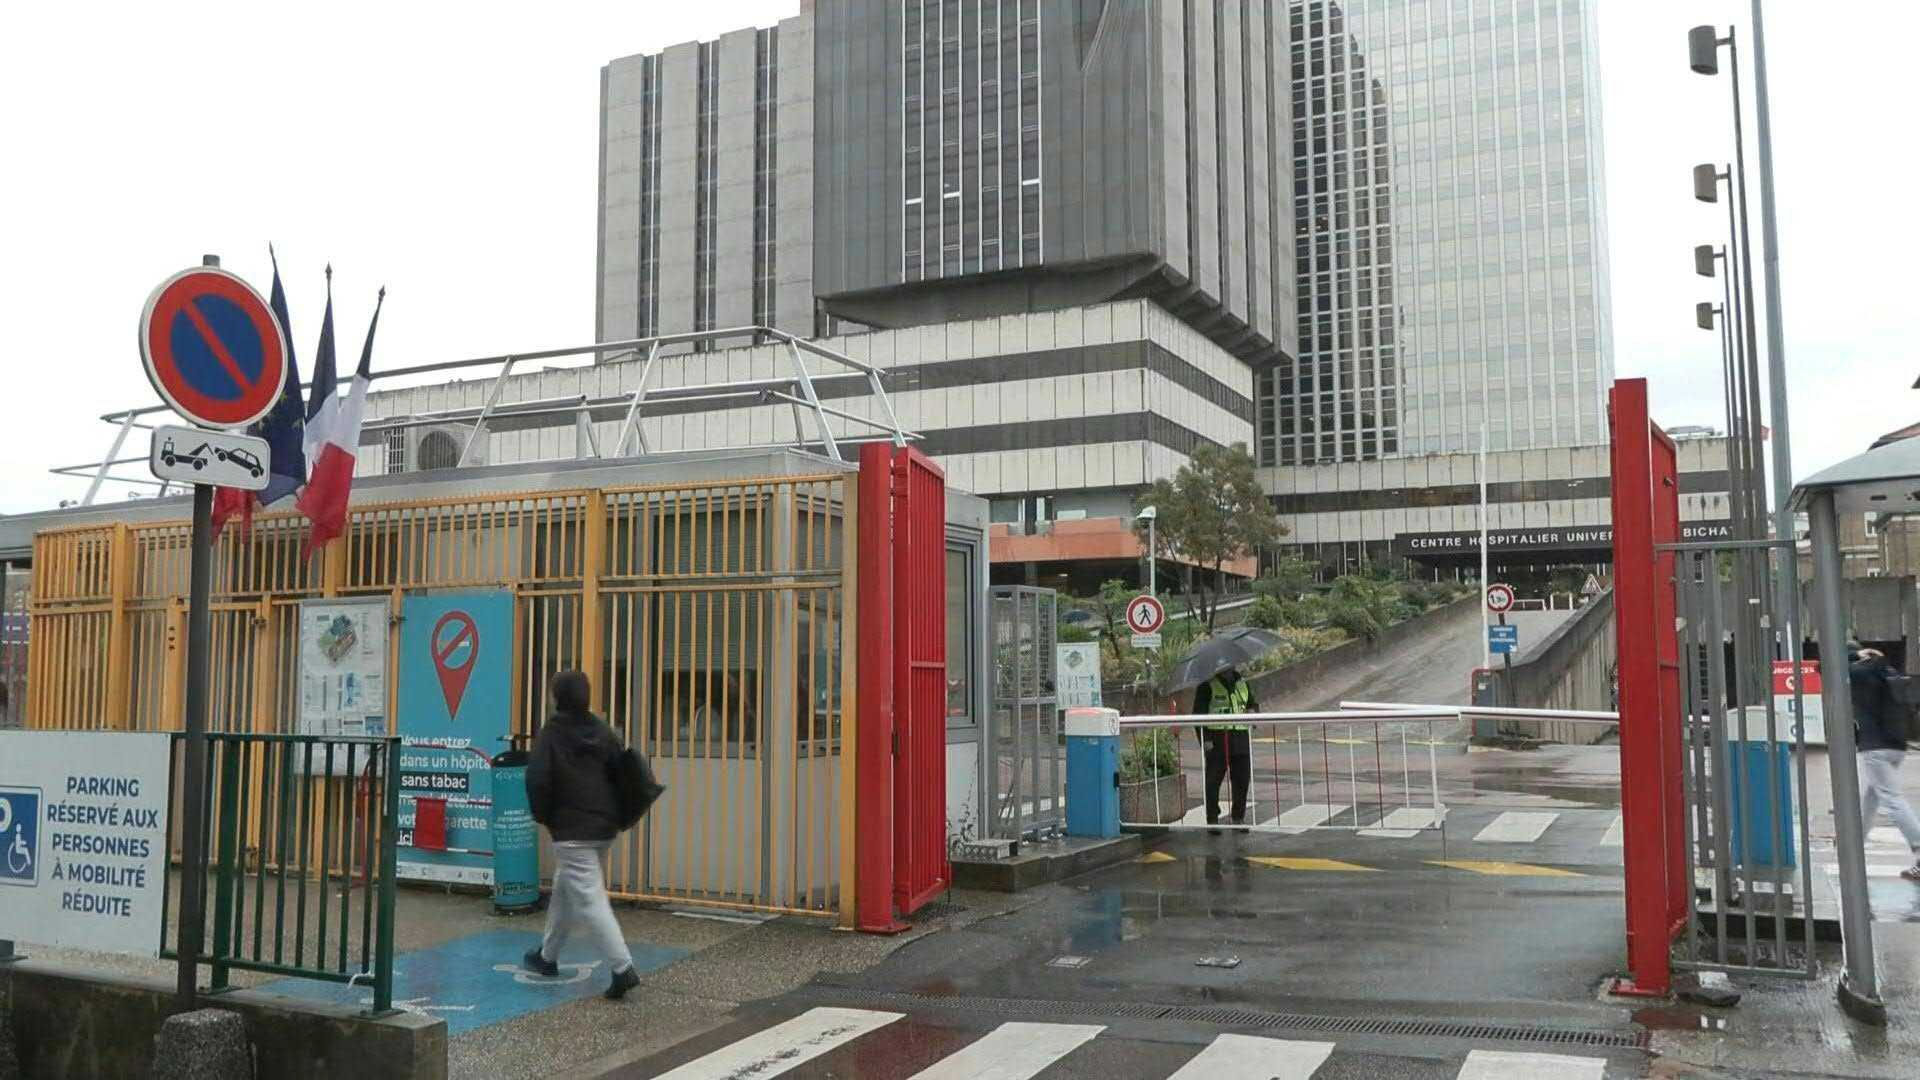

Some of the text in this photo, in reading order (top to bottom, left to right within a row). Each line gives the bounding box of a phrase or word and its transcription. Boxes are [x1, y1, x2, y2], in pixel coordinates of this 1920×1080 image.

[1411, 537, 1462, 548] CENTRE
[1682, 526, 1733, 538] BICHA
[431, 737, 472, 749] entrez
[400, 753, 492, 771] dans un hôpita
[67, 776, 140, 797] PARKING
[401, 774, 467, 789] sans tabac
[47, 799, 158, 828] RÉSERVÉ AUX
[52, 833, 150, 858] PERSONNES
[52, 857, 146, 888] À MOBILITÉ
[62, 888, 131, 917] RÉDUITE
